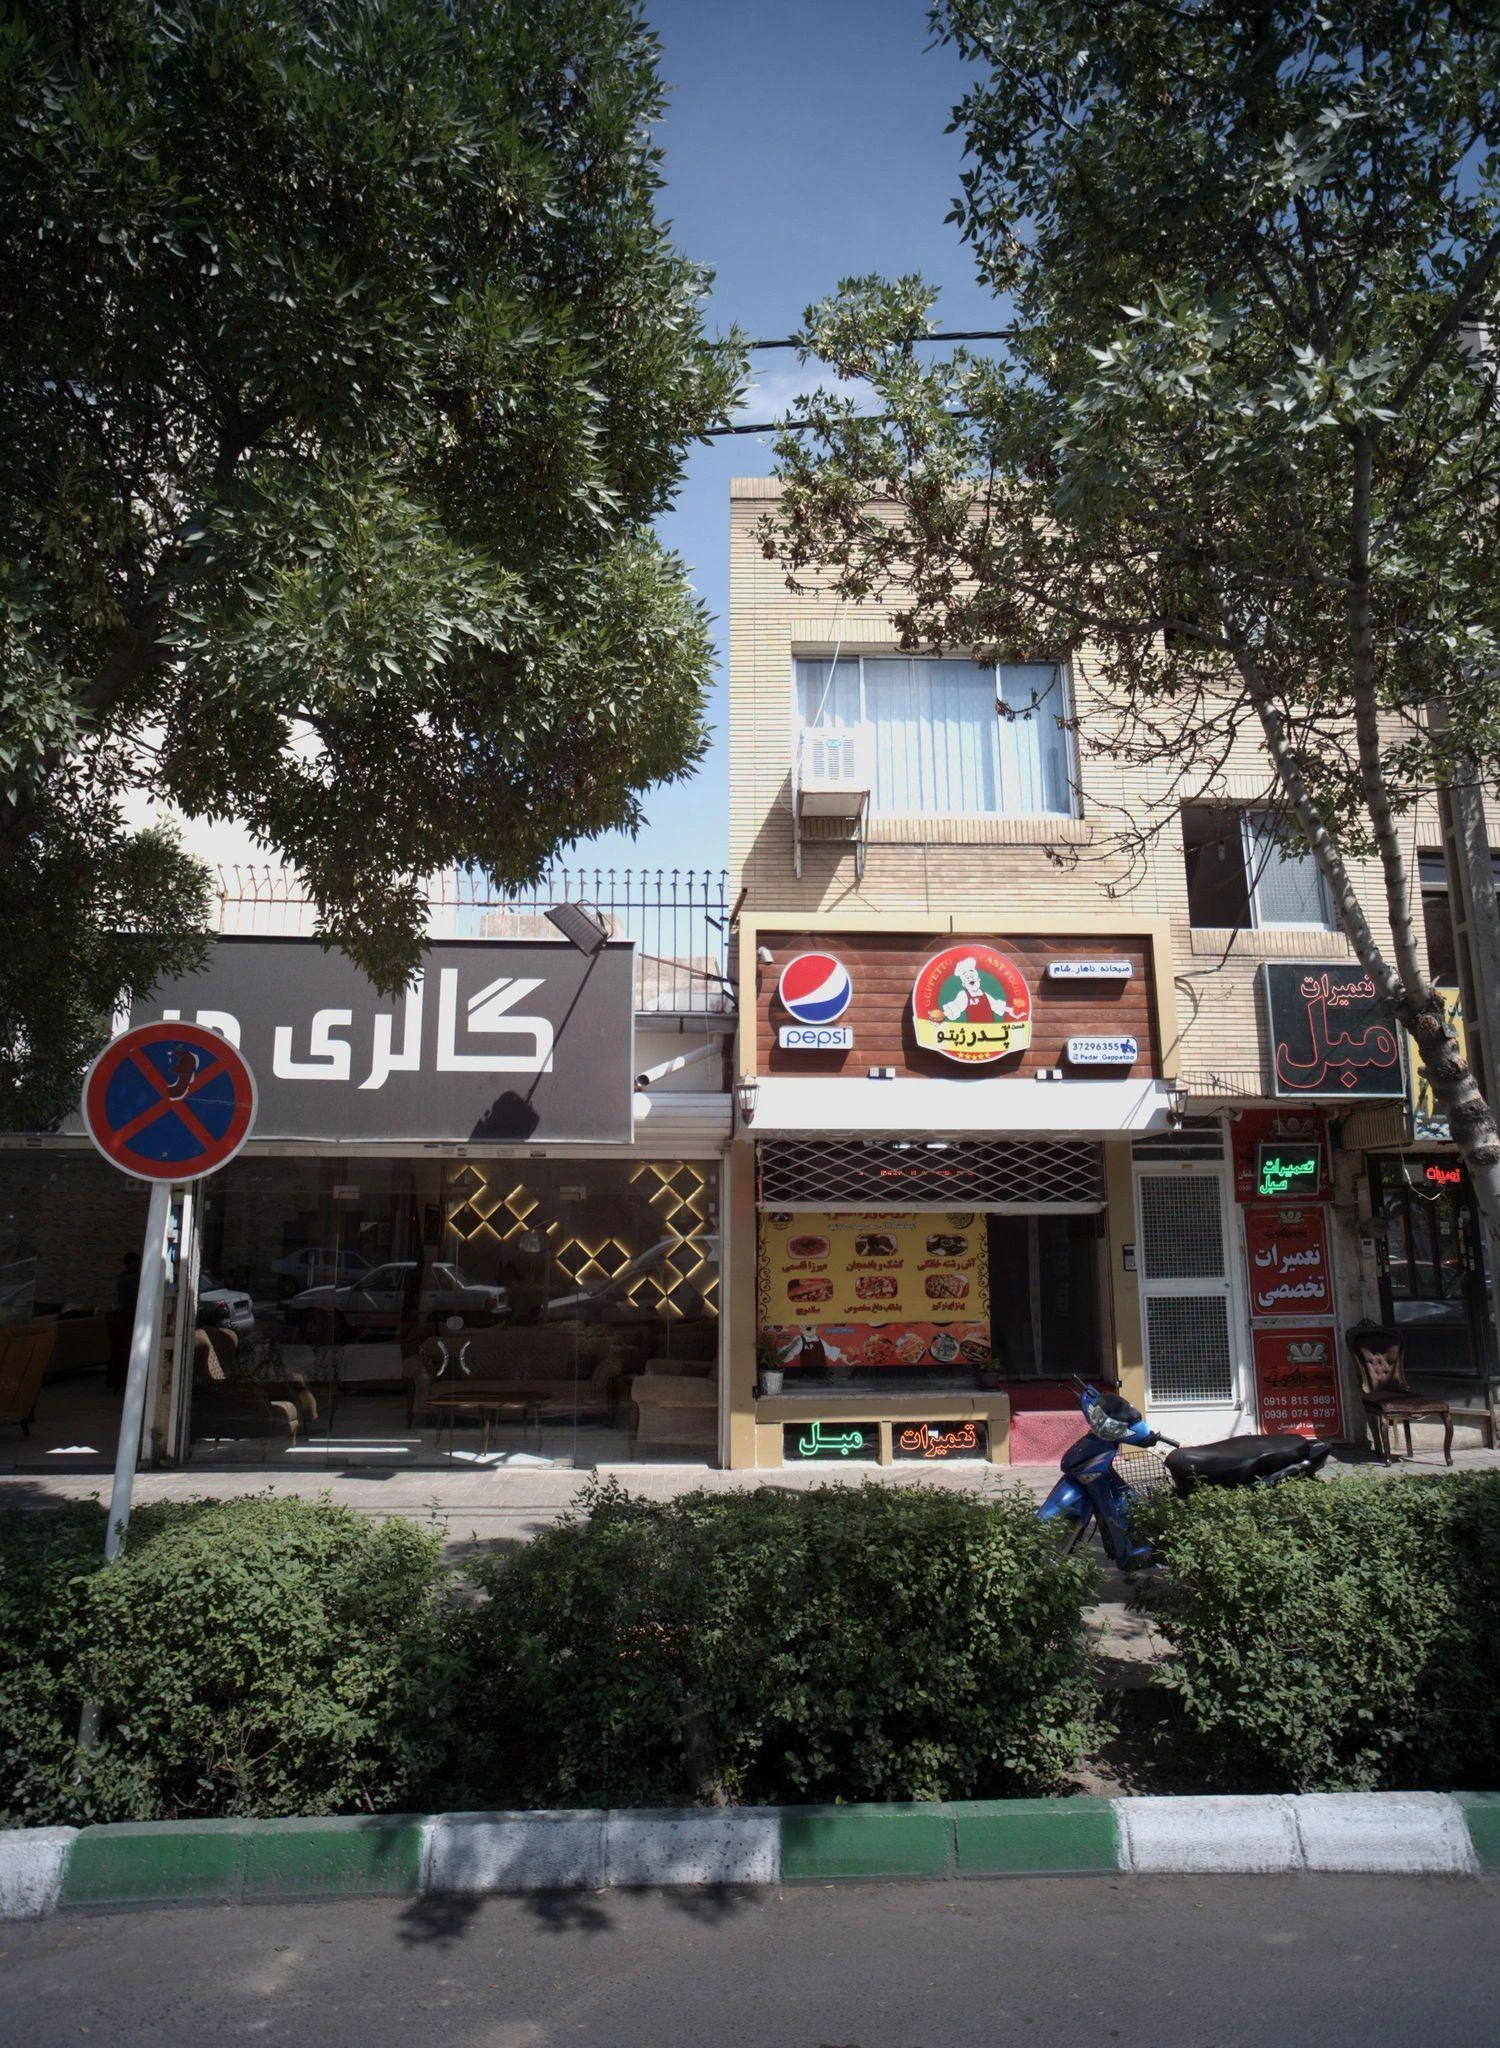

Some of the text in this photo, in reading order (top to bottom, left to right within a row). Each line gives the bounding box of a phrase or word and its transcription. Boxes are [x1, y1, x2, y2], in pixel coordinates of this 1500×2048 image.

[1054, 964, 1130, 974] صبحانه ناهار شام
[272, 967, 555, 1090] گالری
[786, 1028, 848, 1048] pepsi
[937, 1027, 1010, 1049] پدر ژپتو
[1072, 1043, 1119, 1051] 37296355
[1276, 994, 1398, 1089] مبل
[1262, 1157, 1315, 1178] تعمیرات
[1259, 1174, 1288, 1194] مبل
[1255, 1243, 1321, 1274] تعمیرات
[1258, 1275, 1326, 1307] تخصصی
[1263, 1395, 1335, 1406] 0915 815 9691
[1291, 1409, 1309, 1418] 074
[1312, 1408, 1336, 1418] 9787
[799, 1421, 976, 1457] تعمیرات مبل
